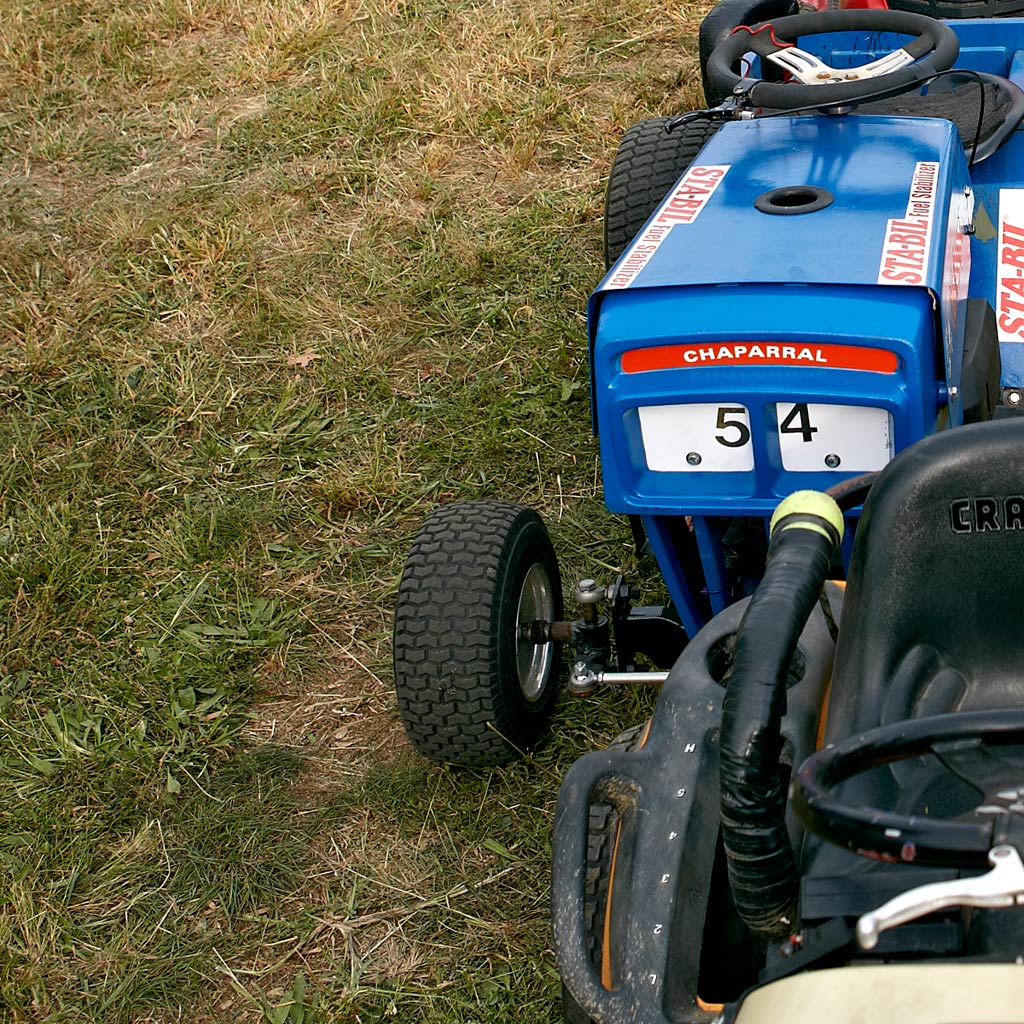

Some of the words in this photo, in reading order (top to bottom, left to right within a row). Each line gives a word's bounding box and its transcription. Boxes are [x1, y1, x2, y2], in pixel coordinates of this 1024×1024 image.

[657, 166, 725, 223] STA-BIL
[911, 162, 936, 199] Stabilizer
[908, 198, 930, 220] Fuel
[644, 224, 664, 243] Fuel
[881, 219, 929, 284] STA-BIL
[609, 244, 657, 288] Stabilizer
[683, 345, 827, 363] CHAPARRAL
[715, 407, 751, 448] 5
[780, 403, 818, 443] 4
